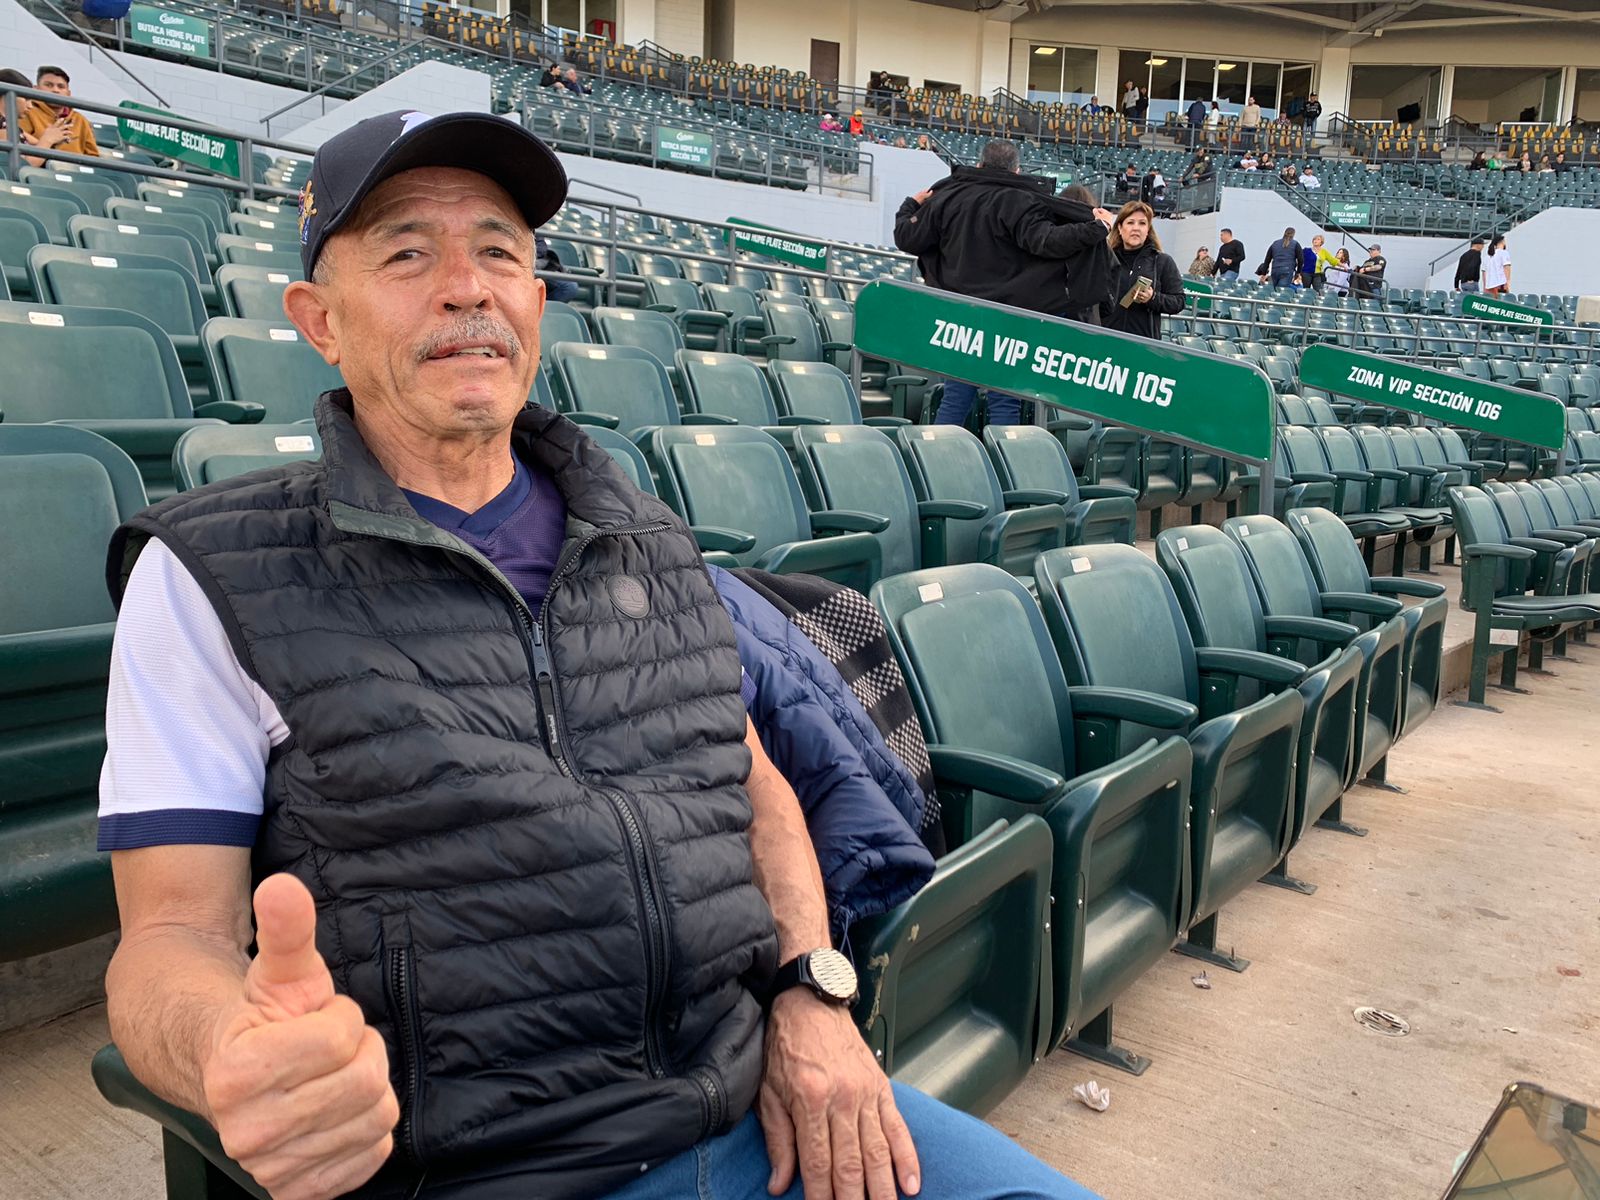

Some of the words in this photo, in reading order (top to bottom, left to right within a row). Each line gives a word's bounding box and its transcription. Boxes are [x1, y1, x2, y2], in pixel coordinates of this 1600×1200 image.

[137, 22, 165, 36] BUTACA
[166, 28, 184, 40] HOME
[185, 32, 206, 44] PLATE
[152, 36, 181, 49] SECCIÓN
[182, 42, 195, 52] 304
[145, 122, 160, 137] HOME
[160, 126, 180, 143] PLATE
[181, 131, 210, 155] SECCIÓN
[210, 141, 226, 159] 207
[693, 146, 708, 155] PLATE
[735, 231, 751, 241] ALCO
[751, 233, 766, 245] HOME
[766, 237, 782, 249] PLATE
[782, 240, 804, 256] SECCIÓN
[804, 246, 817, 259] 208
[1472, 302, 1488, 312] PALCO
[1488, 306, 1500, 315] HOME
[1500, 309, 1514, 319] PLATE
[1514, 312, 1534, 324] SECCIÓN
[929, 318, 985, 358] ZONA
[993, 334, 1029, 367] VIP
[1031, 346, 1130, 395] SECCIÓN
[1132, 371, 1177, 407] 105
[1347, 366, 1384, 389] ZONA
[1388, 376, 1412, 395] VIP
[1412, 383, 1474, 413] SECCIÓN
[1475, 400, 1502, 421] 106
